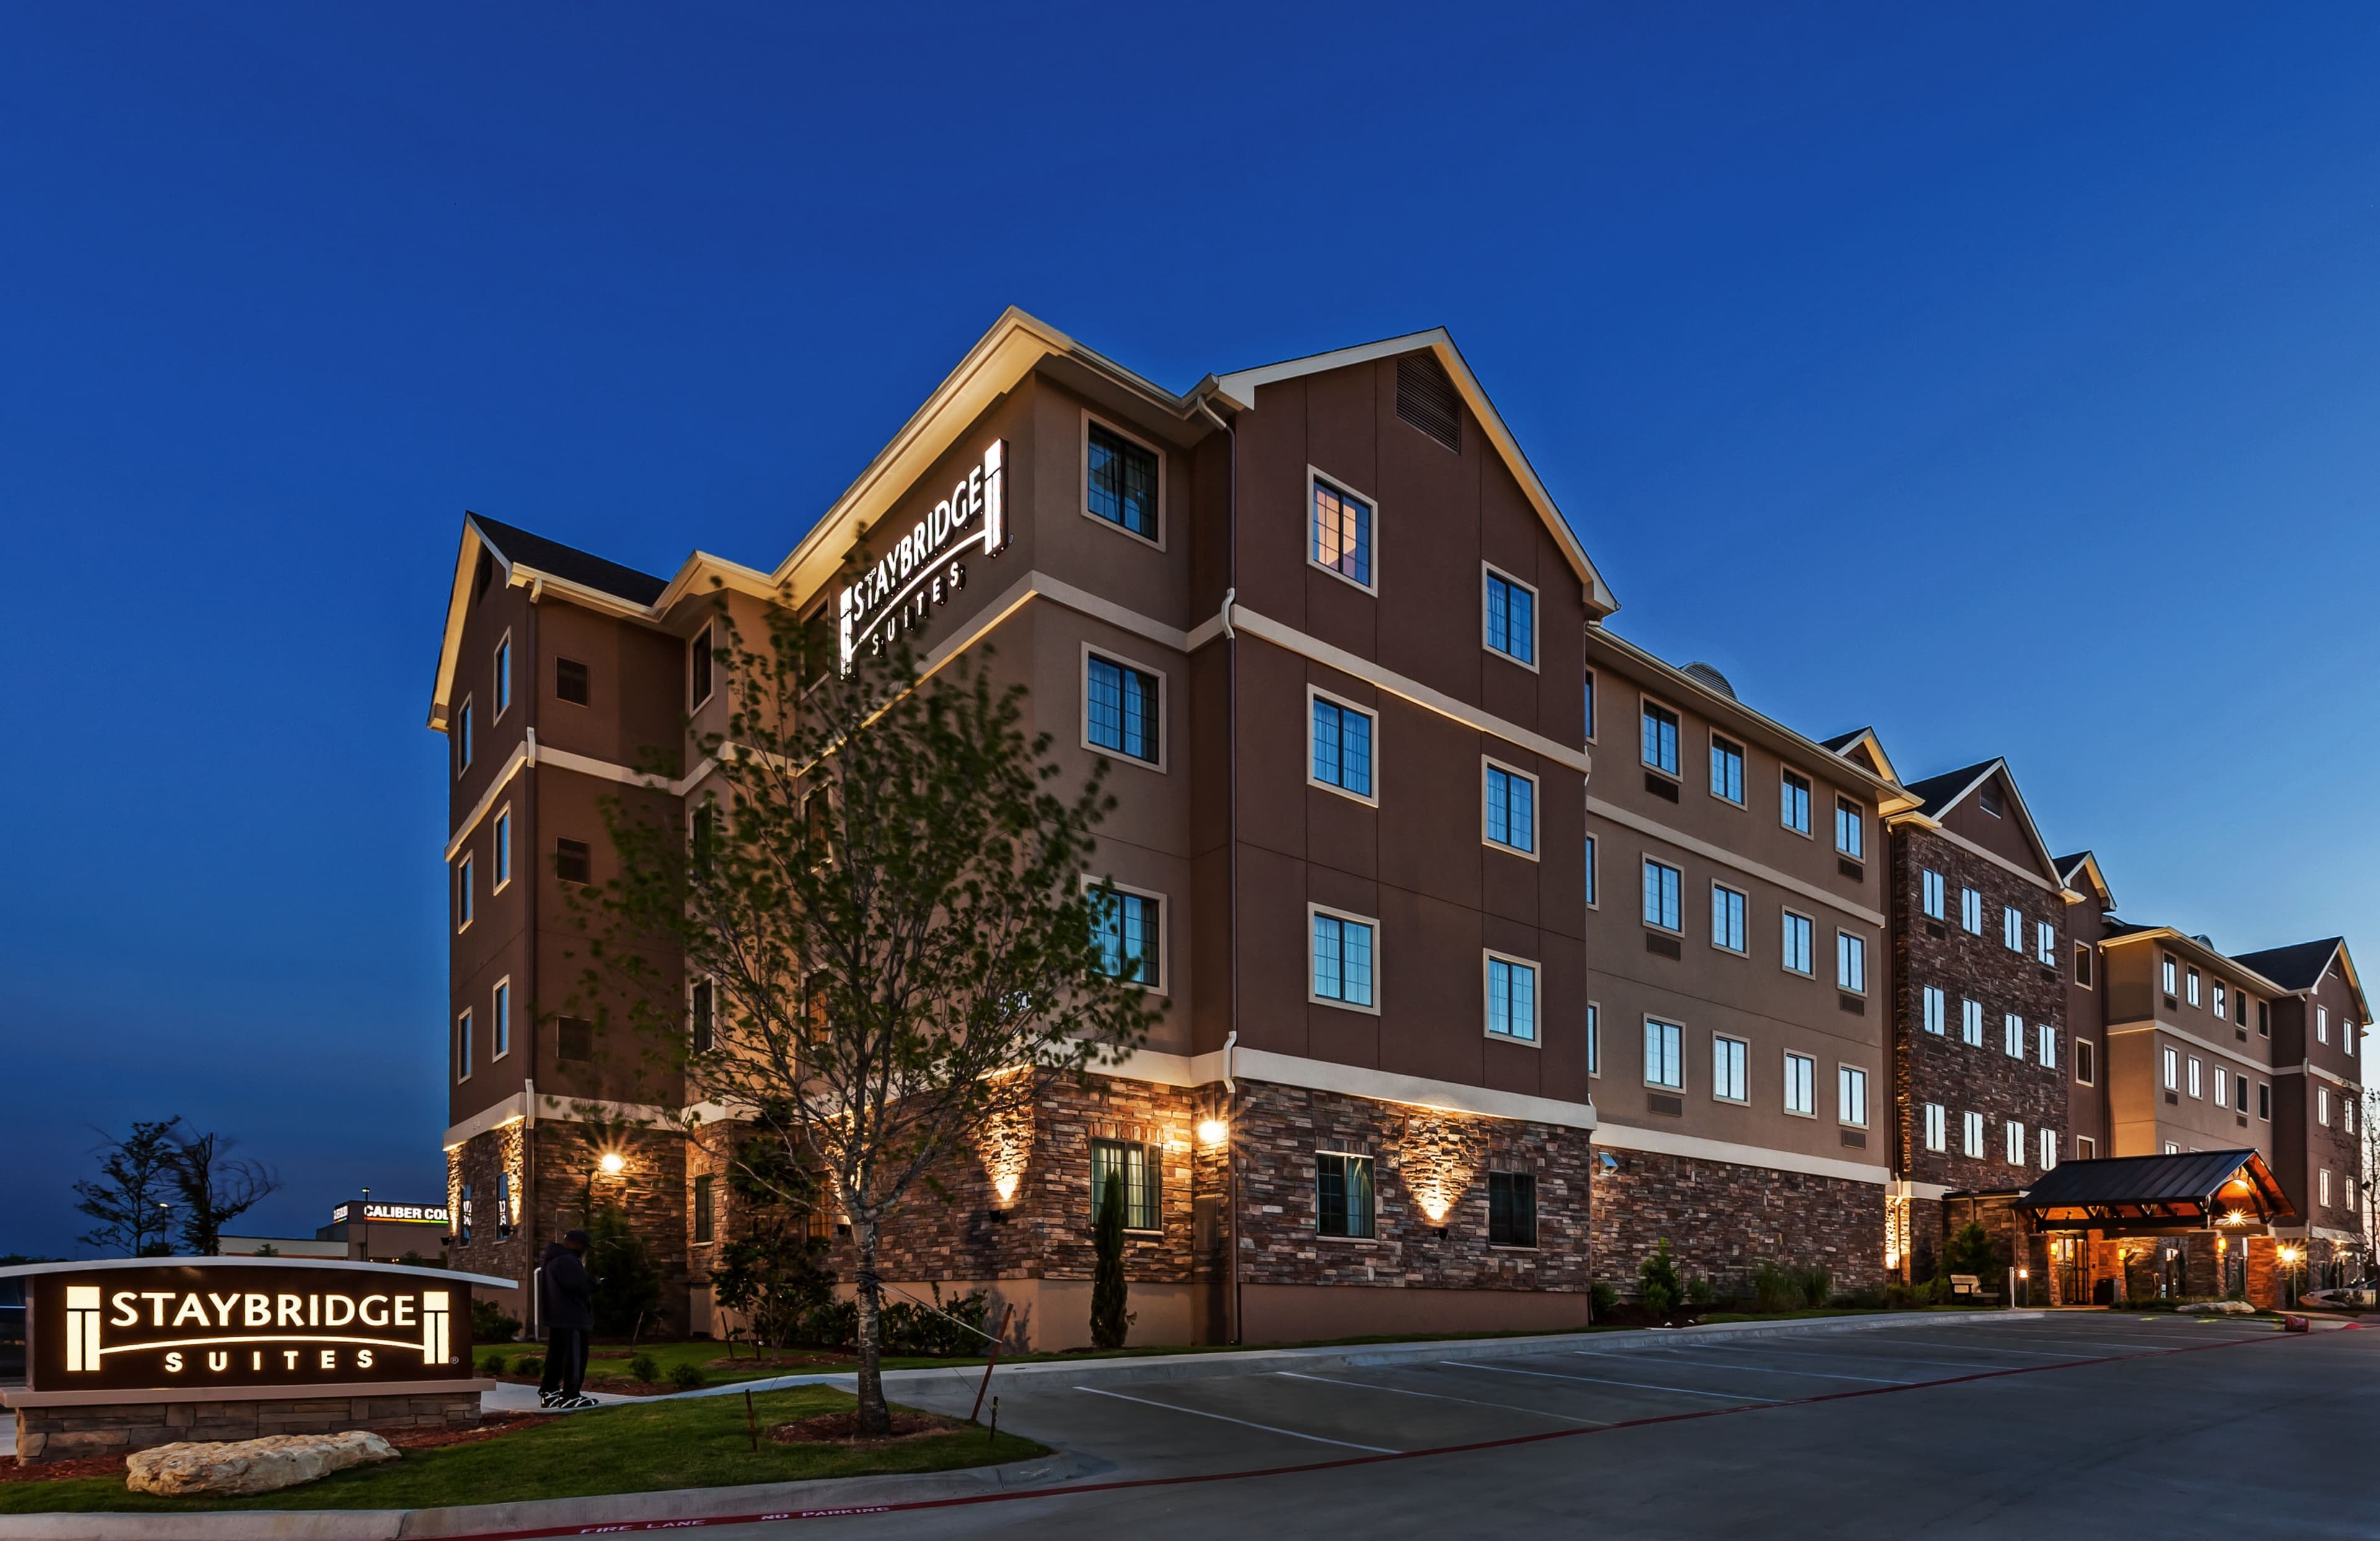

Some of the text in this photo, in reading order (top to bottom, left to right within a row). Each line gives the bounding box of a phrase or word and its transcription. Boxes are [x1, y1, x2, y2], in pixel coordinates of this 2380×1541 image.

[853, 464, 982, 621] STAYBRIDGE
[872, 562, 959, 656] SUITES
[364, 1205, 422, 1219] CALIBER
[110, 1292, 416, 1327] STAYBRIDGE
[165, 1350, 373, 1372] SUITES
[580, 1525, 633, 1534] FIRE
[646, 1520, 706, 1529] LANE
[802, 1508, 890, 1517] PARKING
